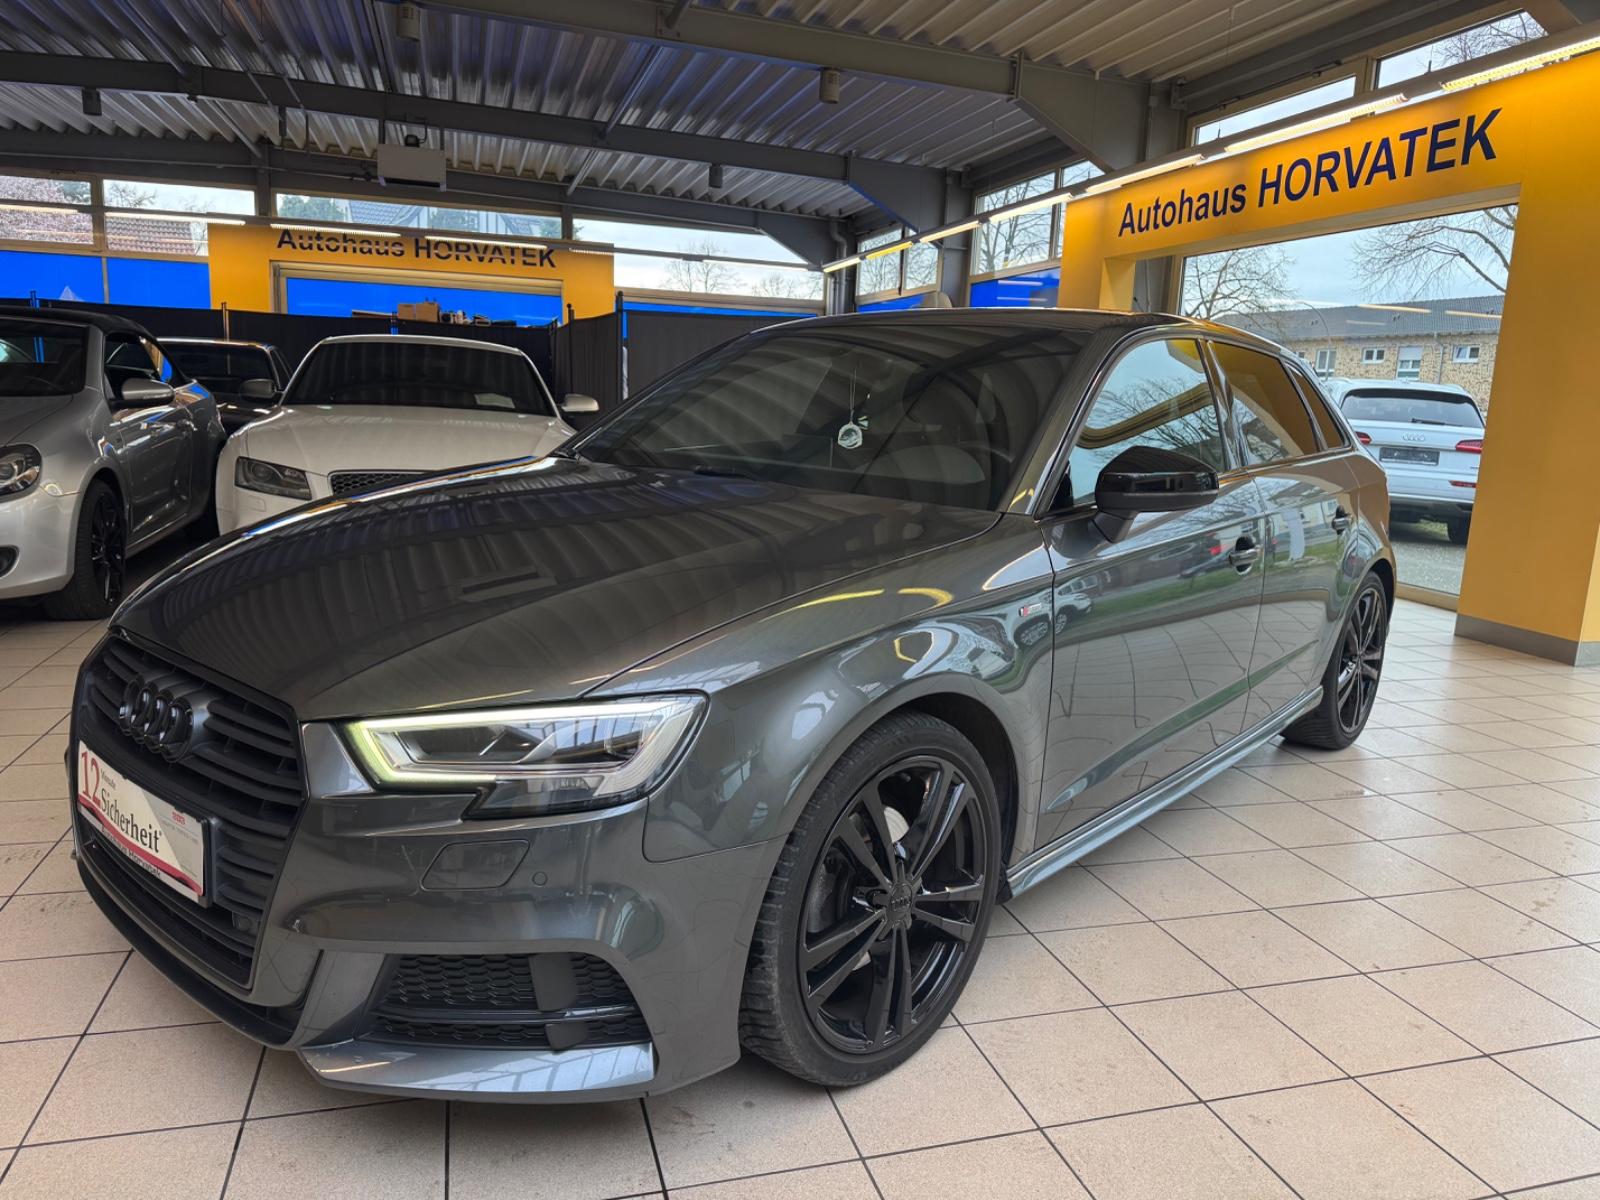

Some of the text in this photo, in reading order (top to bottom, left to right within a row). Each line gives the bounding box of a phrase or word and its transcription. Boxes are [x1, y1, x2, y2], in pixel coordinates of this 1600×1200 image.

[1118, 107, 1503, 238] Autohaus HORVATEK
[277, 229, 557, 268] Autohaus HORVATEK
[81, 751, 102, 809] 12
